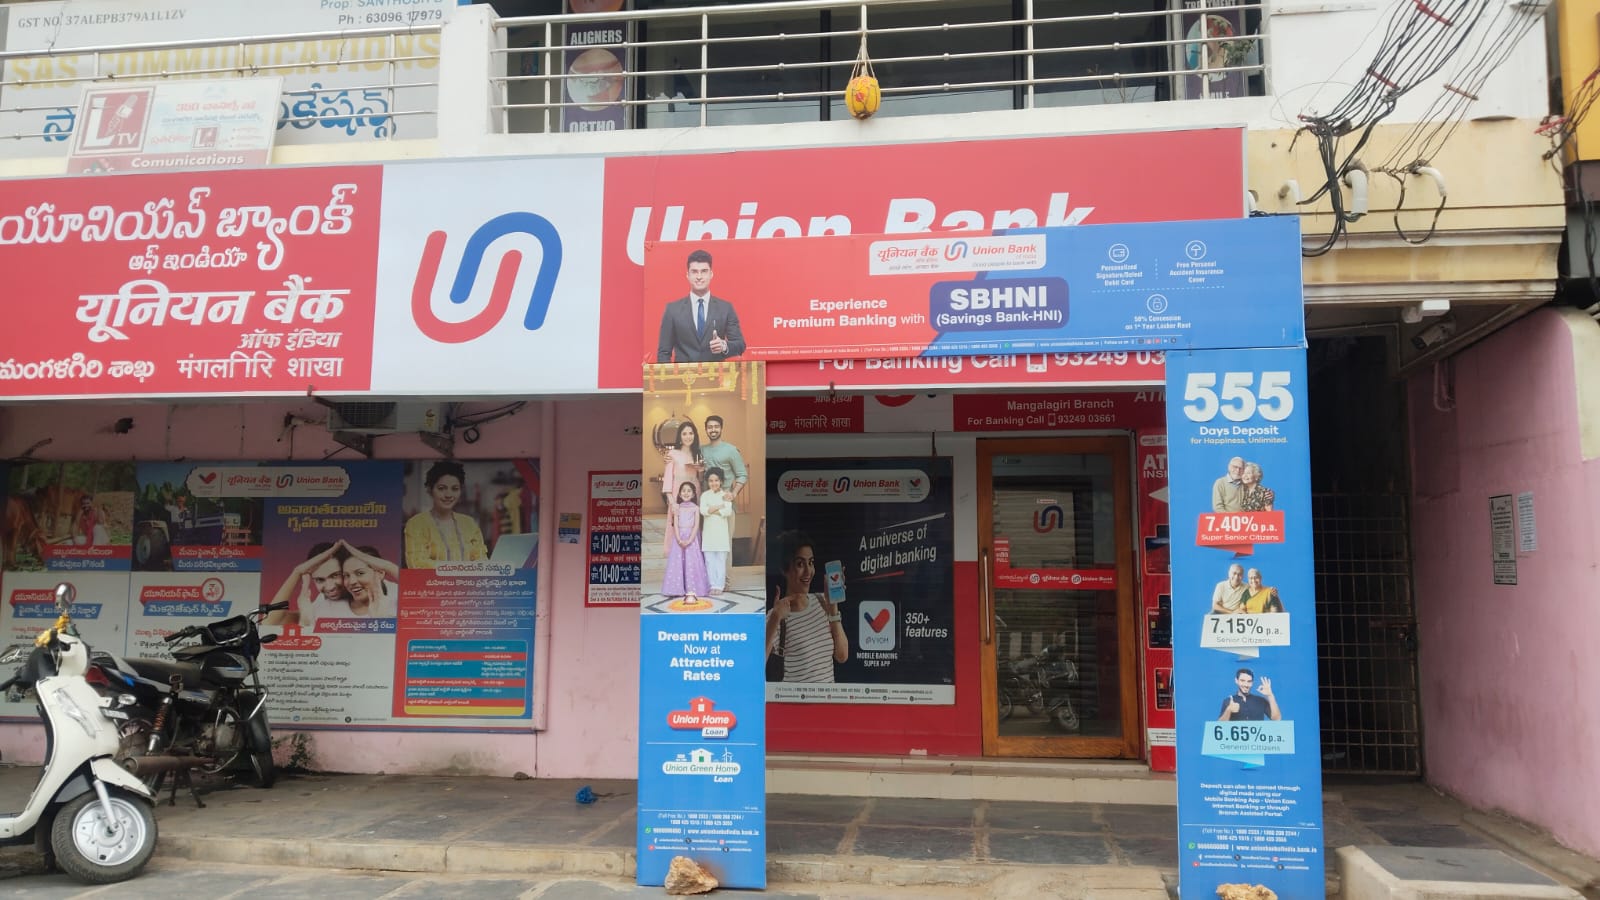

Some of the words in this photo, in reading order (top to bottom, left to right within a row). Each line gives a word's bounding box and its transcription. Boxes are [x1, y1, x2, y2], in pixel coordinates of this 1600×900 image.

[1185, 0, 1236, 9] TRETMENT
[18, 18, 42, 28] GST
[338, 14, 354, 25] Ph
[366, 11, 402, 23] 63096
[406, 9, 443, 22] 17979
[570, 29, 623, 46] ALIGNERS
[10, 55, 79, 90] SAS
[98, 35, 440, 83] COMMUNICATIONS
[569, 120, 616, 133] ORTHO
[117, 133, 139, 146] TV
[131, 153, 244, 169] Comunications
[0, 187, 211, 246] యూనియన్
[216, 183, 358, 271] బ్యాంక్
[877, 246, 917, 263] यूनियन
[973, 245, 1004, 256] Union
[1008, 243, 1037, 255] Bank
[163, 246, 248, 270] ఇండియా
[1191, 260, 1217, 268] Personal
[1195, 268, 1224, 276] Insurance
[1188, 276, 1206, 284] Cover
[950, 286, 1049, 311] SBHNI
[75, 279, 256, 343] यूनियन
[263, 274, 351, 324] बैंक
[810, 298, 888, 314] Experience
[774, 315, 836, 329] Premium
[839, 313, 897, 330] Banking
[900, 312, 925, 325] with
[936, 312, 993, 328] (Savings
[996, 309, 1063, 325] Bank-HNI)
[237, 329, 284, 350] ऑफ
[286, 328, 343, 352] इंडिया
[0, 353, 103, 382] మంగళగిరి
[107, 358, 156, 384] శాఖ
[288, 357, 344, 378] शाखा
[819, 356, 855, 371] For
[865, 354, 963, 375] Banking
[971, 353, 1017, 370] Call
[1183, 371, 1294, 423] 555
[1007, 400, 1071, 413] Mangalagiri
[1074, 399, 1114, 409] Branch
[794, 415, 828, 429] मंगलगिरि
[831, 417, 851, 428] शाखा
[967, 416, 982, 426] For
[985, 416, 1022, 427] Banking
[1024, 414, 1045, 425] Call
[1057, 413, 1086, 424] 93249
[1088, 412, 1116, 424] 03661
[1200, 426, 1230, 437] Days
[1232, 425, 1279, 437] Deposit
[1191, 437, 1201, 445] for
[1248, 436, 1288, 444] Unlimited.
[227, 475, 257, 487] यूनियन
[296, 475, 320, 484] Union
[322, 475, 344, 484] Bank
[784, 478, 813, 491] यूनियन
[853, 479, 877, 489] Union
[879, 479, 900, 488] Bank
[1206, 515, 1259, 533] 7.40%
[1260, 522, 1278, 534] p.a.
[859, 534, 868, 552] A
[869, 528, 914, 550] universe
[916, 523, 928, 540] of
[1201, 534, 1224, 543] Super
[1224, 534, 1248, 542] Senior
[1249, 534, 1279, 542] Citizens
[860, 552, 893, 575] digital
[895, 546, 937, 567] banking
[438, 563, 483, 573] యూనియన్
[144, 588, 182, 599] యూనియన్
[905, 612, 930, 625] 350+
[905, 625, 948, 638] features
[1211, 618, 1264, 635] 7.15%
[1265, 625, 1284, 637] p.a.
[658, 631, 700, 642] Dream
[702, 630, 748, 642] Homes
[1216, 636, 1240, 645] Senior
[1242, 636, 1272, 645] Citizens
[684, 644, 708, 655] Now
[710, 644, 721, 655] at
[856, 652, 875, 660] MOBILE
[875, 652, 898, 660] BANKING
[670, 657, 735, 668] Attractive
[683, 670, 721, 682] Rates
[672, 715, 699, 725] Union
[702, 715, 730, 725] Home
[705, 728, 724, 736] Loan
[1214, 725, 1267, 744] 6.65%
[1268, 732, 1286, 744] p.a.
[1220, 743, 1250, 752] General
[1251, 744, 1281, 752] Citizens
[665, 763, 688, 773] Union
[690, 764, 714, 773] Green
[715, 764, 739, 773] Home
[714, 775, 733, 783] Loan
